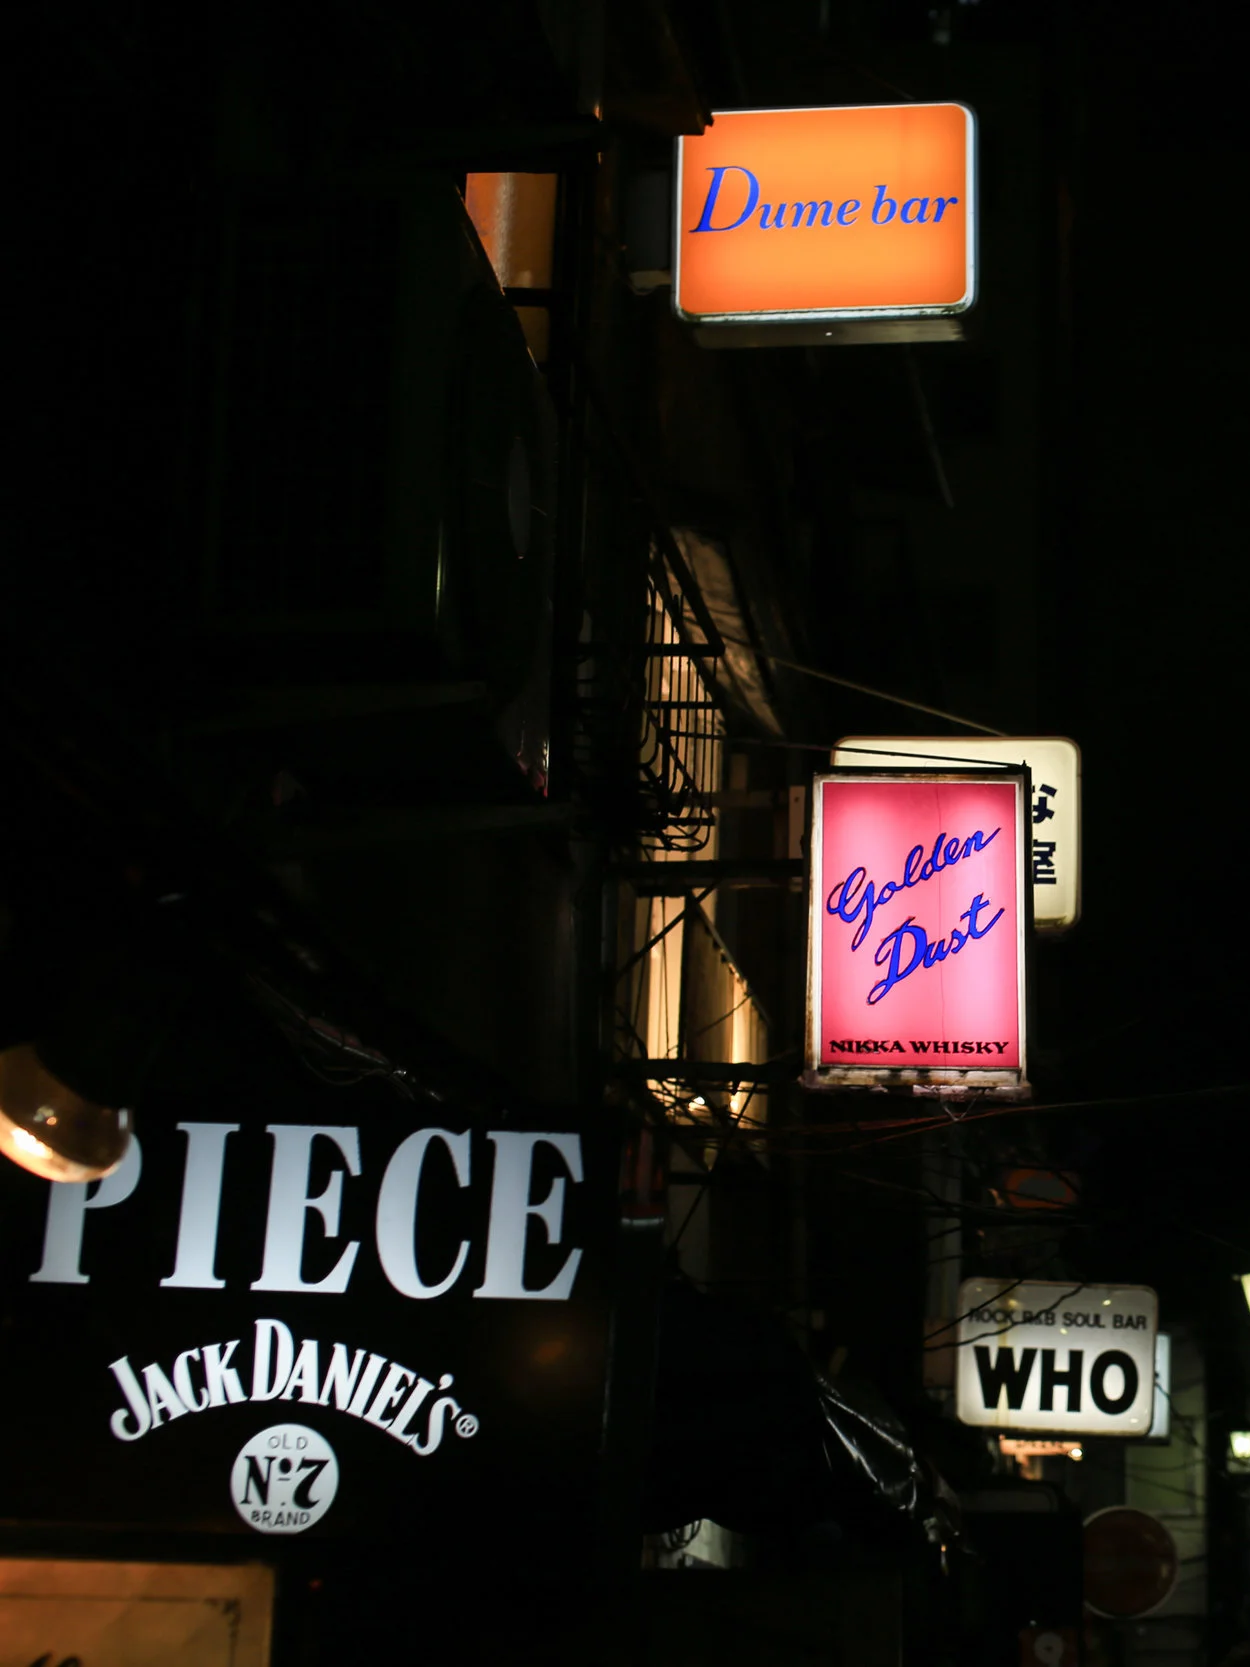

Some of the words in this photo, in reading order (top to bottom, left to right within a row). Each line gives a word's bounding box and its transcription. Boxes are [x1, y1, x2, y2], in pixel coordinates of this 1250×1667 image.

[689, 165, 861, 233] Dume
[871, 185, 959, 226] bar
[826, 827, 1002, 952] Golden
[866, 890, 1006, 1006] Dust
[829, 1039, 906, 1054] NIKKA
[909, 1041, 1010, 1055] WHISKY
[28, 1121, 585, 1301] PIECE
[968, 1308, 1015, 1325] ROCK
[1062, 1312, 1106, 1329] SOUL
[1112, 1313, 1148, 1331] BAR
[108, 1340, 247, 1441] JACK
[973, 1345, 1139, 1416] WHO
[267, 1432, 309, 1450] OLD
[251, 1509, 311, 1528] BRAND
